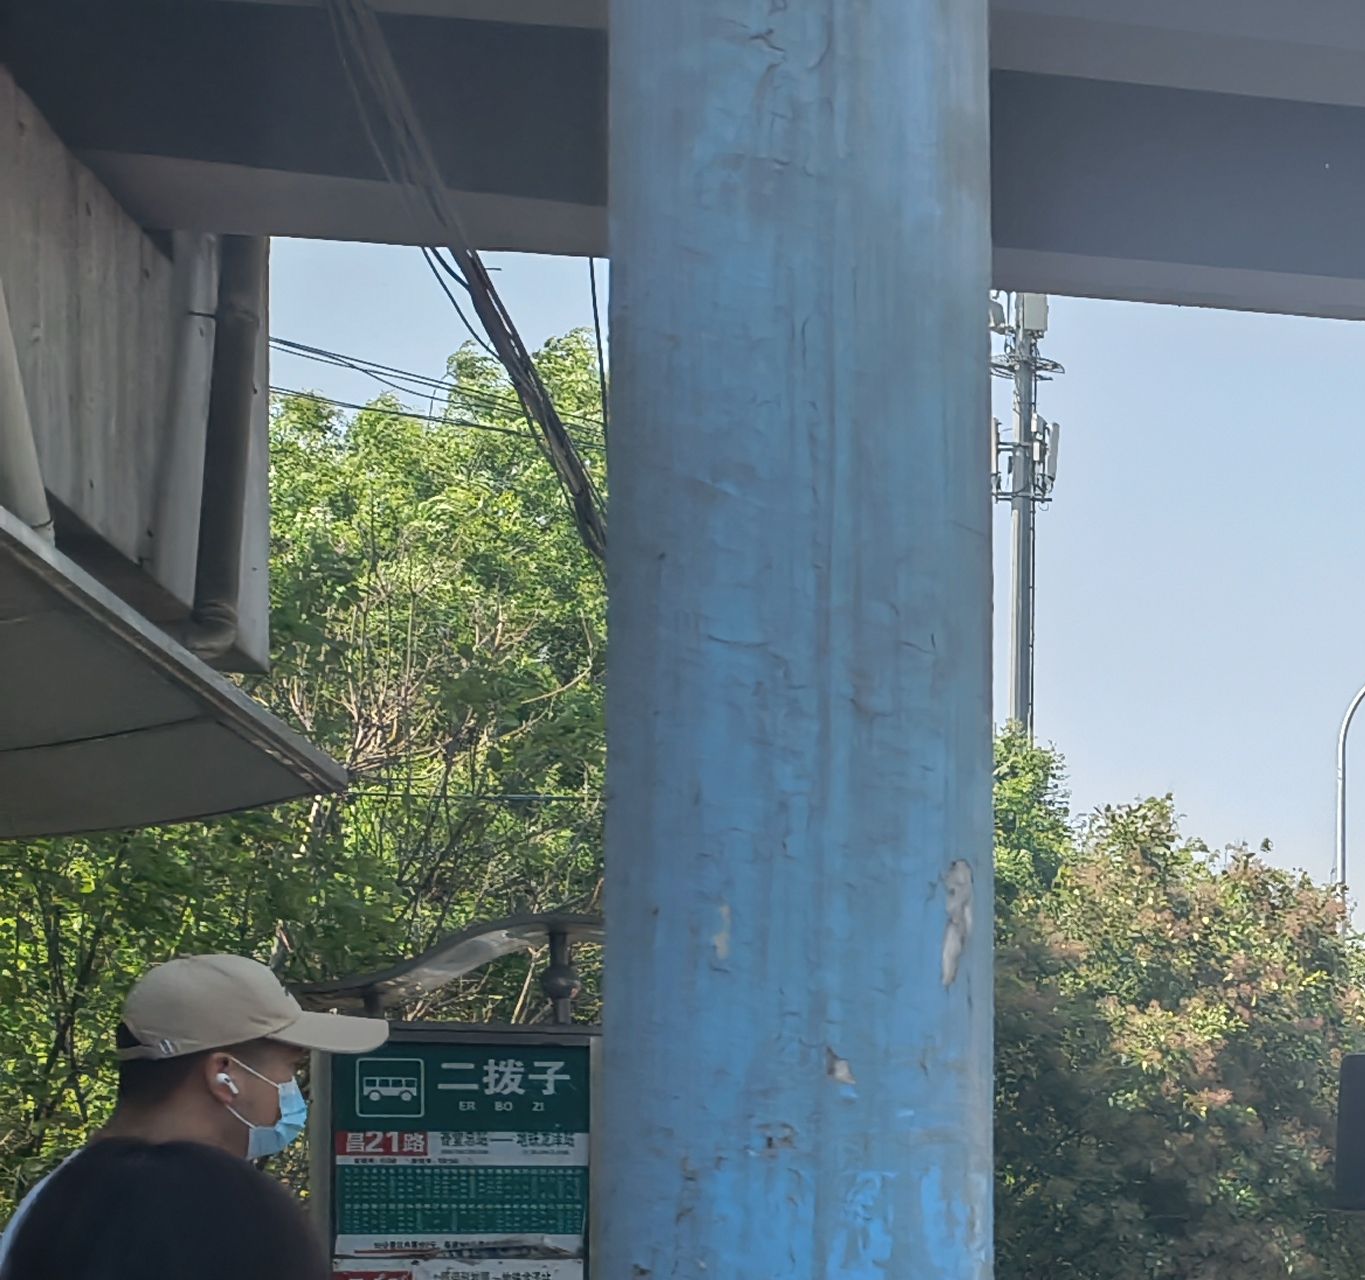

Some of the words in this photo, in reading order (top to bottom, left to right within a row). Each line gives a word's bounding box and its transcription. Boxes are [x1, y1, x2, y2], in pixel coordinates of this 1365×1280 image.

[437, 1059, 571, 1096] 二拨子
[458, 1101, 477, 1111] ER
[494, 1101, 513, 1111] BO
[532, 1102, 545, 1111] ZI
[345, 1131, 425, 1152] 昌21路
